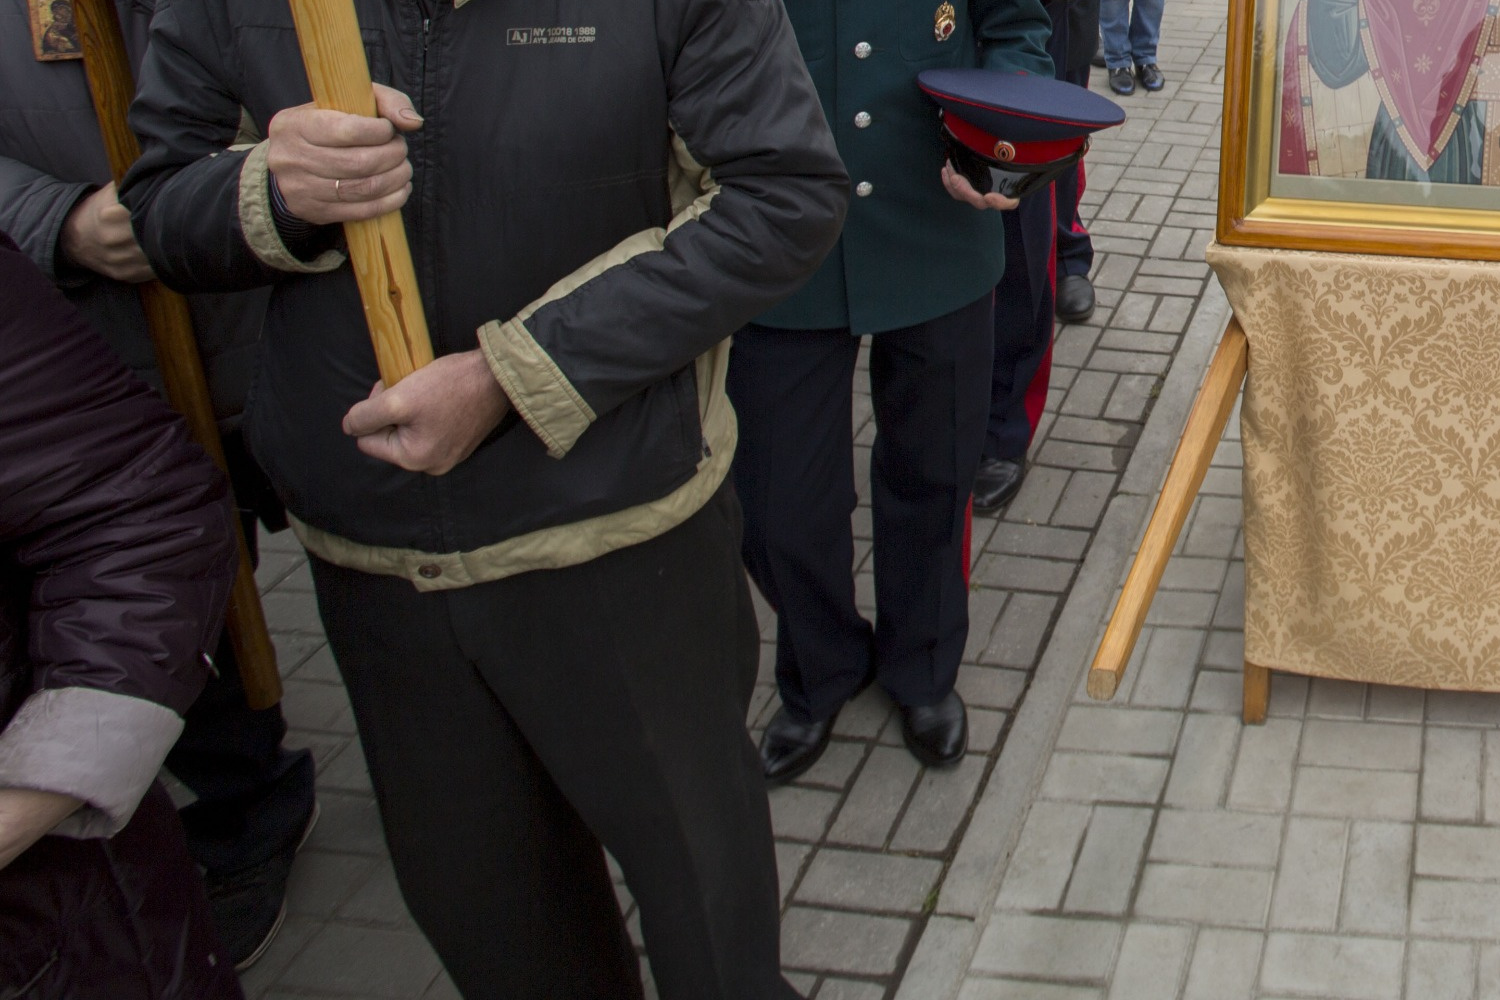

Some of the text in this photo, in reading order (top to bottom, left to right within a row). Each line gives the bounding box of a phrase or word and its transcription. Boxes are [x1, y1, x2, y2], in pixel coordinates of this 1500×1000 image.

[533, 27, 596, 36] NY 10018 1989
